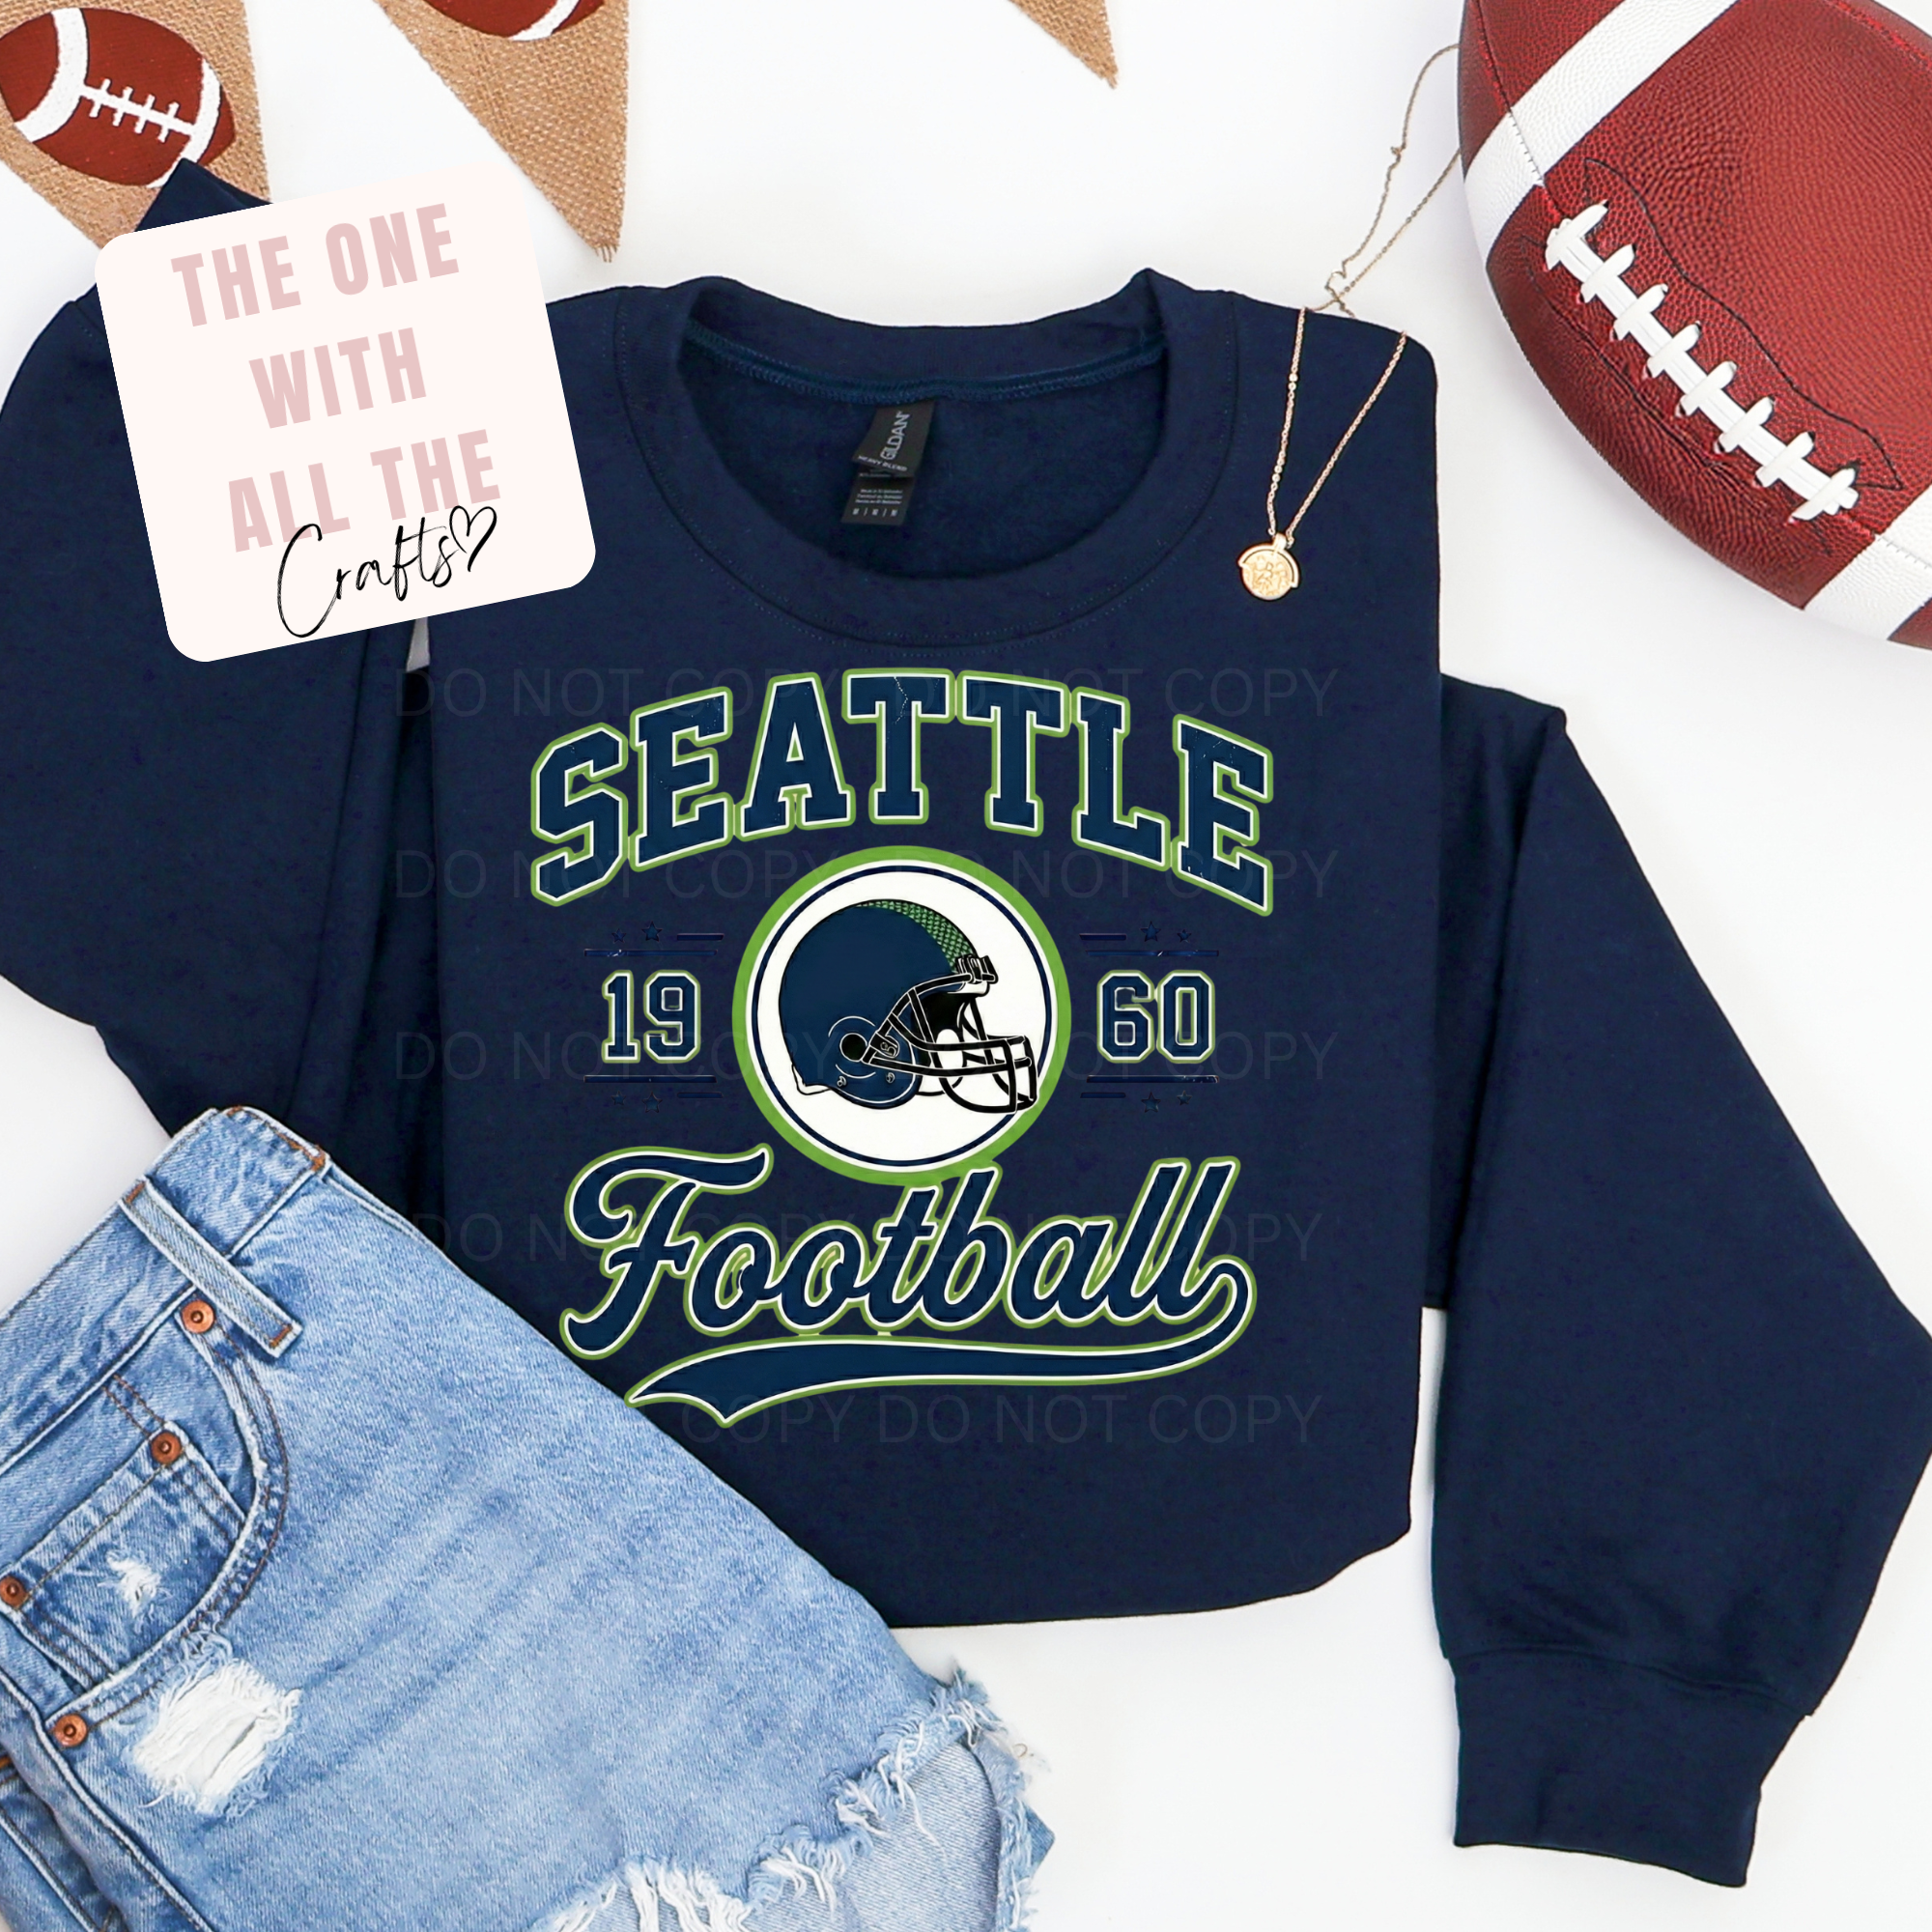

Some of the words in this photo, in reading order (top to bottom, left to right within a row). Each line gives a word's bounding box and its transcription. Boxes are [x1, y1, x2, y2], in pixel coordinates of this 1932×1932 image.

[529, 667, 1274, 917] SEATTLE
[599, 969, 702, 1065] 19
[1095, 969, 1218, 1065] 60
[559, 1144, 1258, 1362] Football
